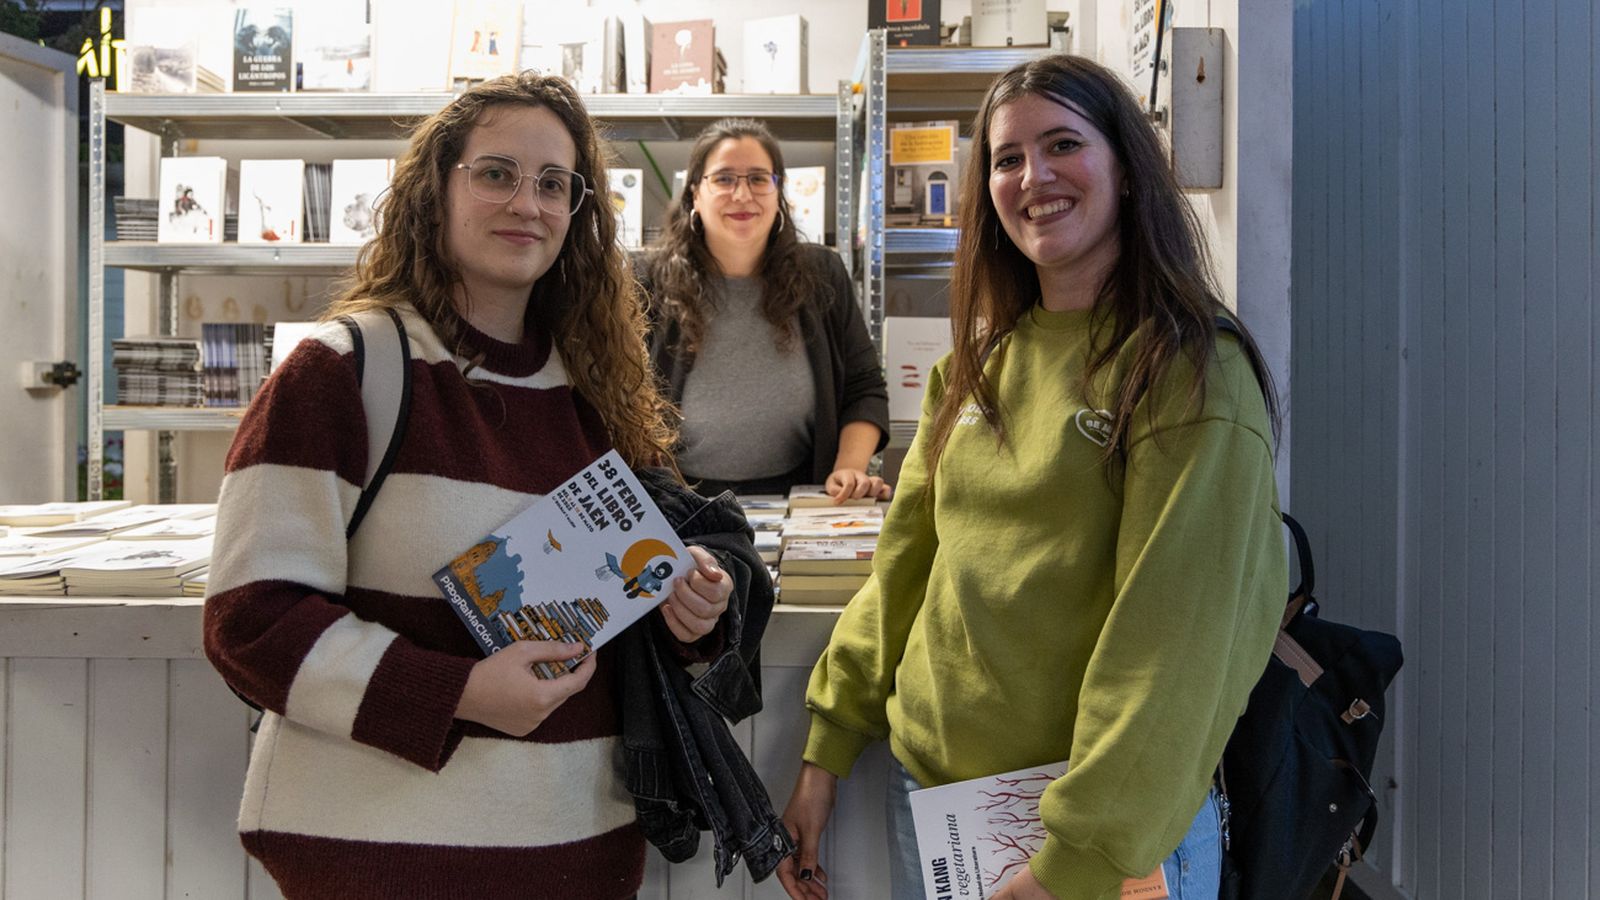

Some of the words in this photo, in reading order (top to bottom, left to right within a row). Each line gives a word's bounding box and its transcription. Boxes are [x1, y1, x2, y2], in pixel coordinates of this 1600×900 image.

[568, 481, 582, 496] DE
[578, 494, 610, 531] JAÉN
[582, 471, 599, 491] DEL
[596, 487, 632, 532] LIBRO
[597, 459, 618, 480] 38
[612, 478, 646, 522] FERIA
[931, 857, 951, 894] KANG
[946, 813, 970, 896] vegetariana
